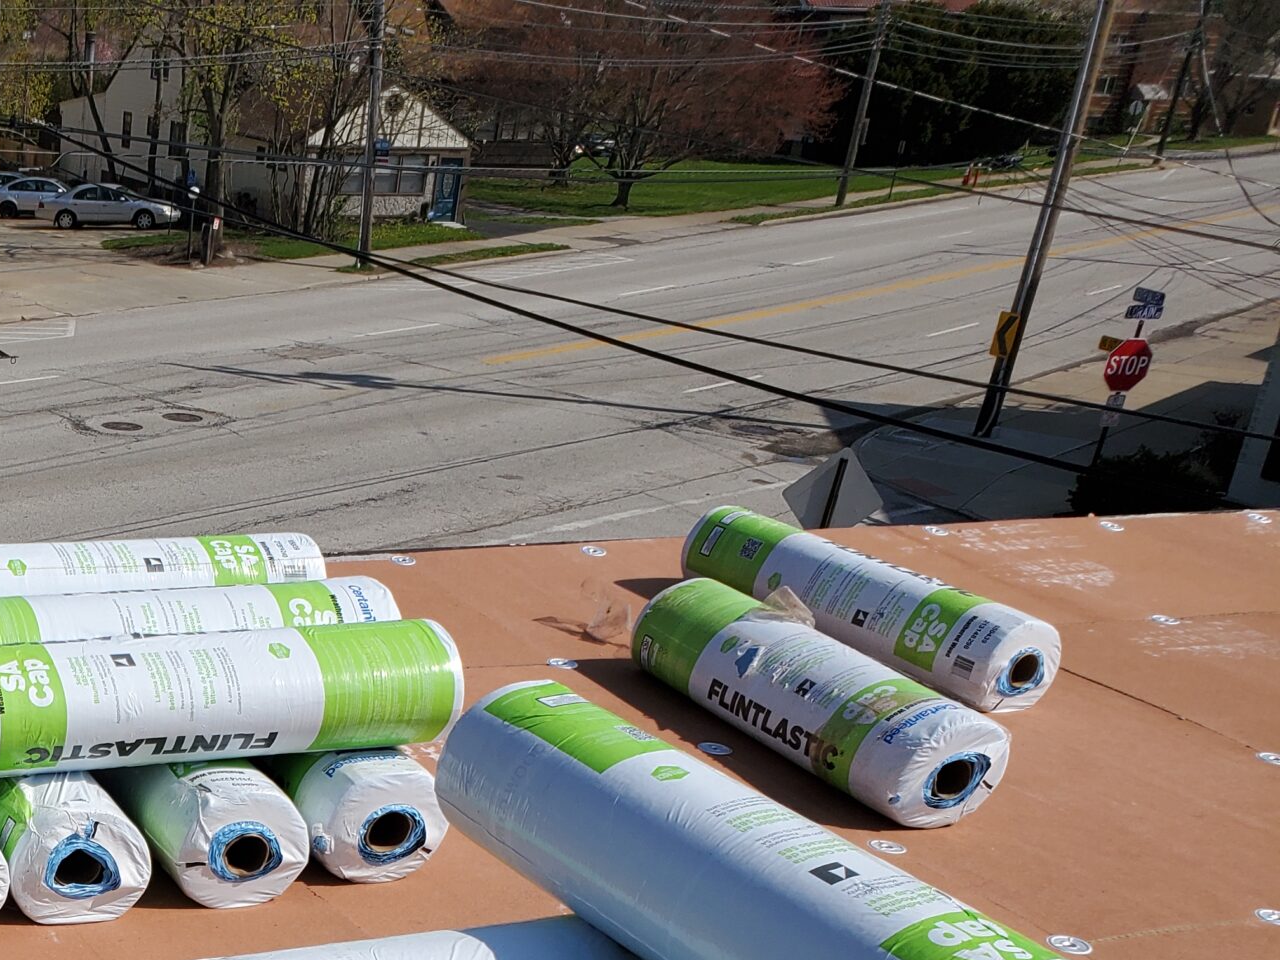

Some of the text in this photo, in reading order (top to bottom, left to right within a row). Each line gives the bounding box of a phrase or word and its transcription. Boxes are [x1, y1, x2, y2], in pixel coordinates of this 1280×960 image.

[1107, 355, 1148, 375] STOP
[904, 604, 941, 648] Cap
[916, 620, 947, 653] SA
[22, 658, 55, 708] Cap
[706, 678, 839, 770] FLINTLASTIC
[24, 731, 279, 767] FLINTLASTIC
